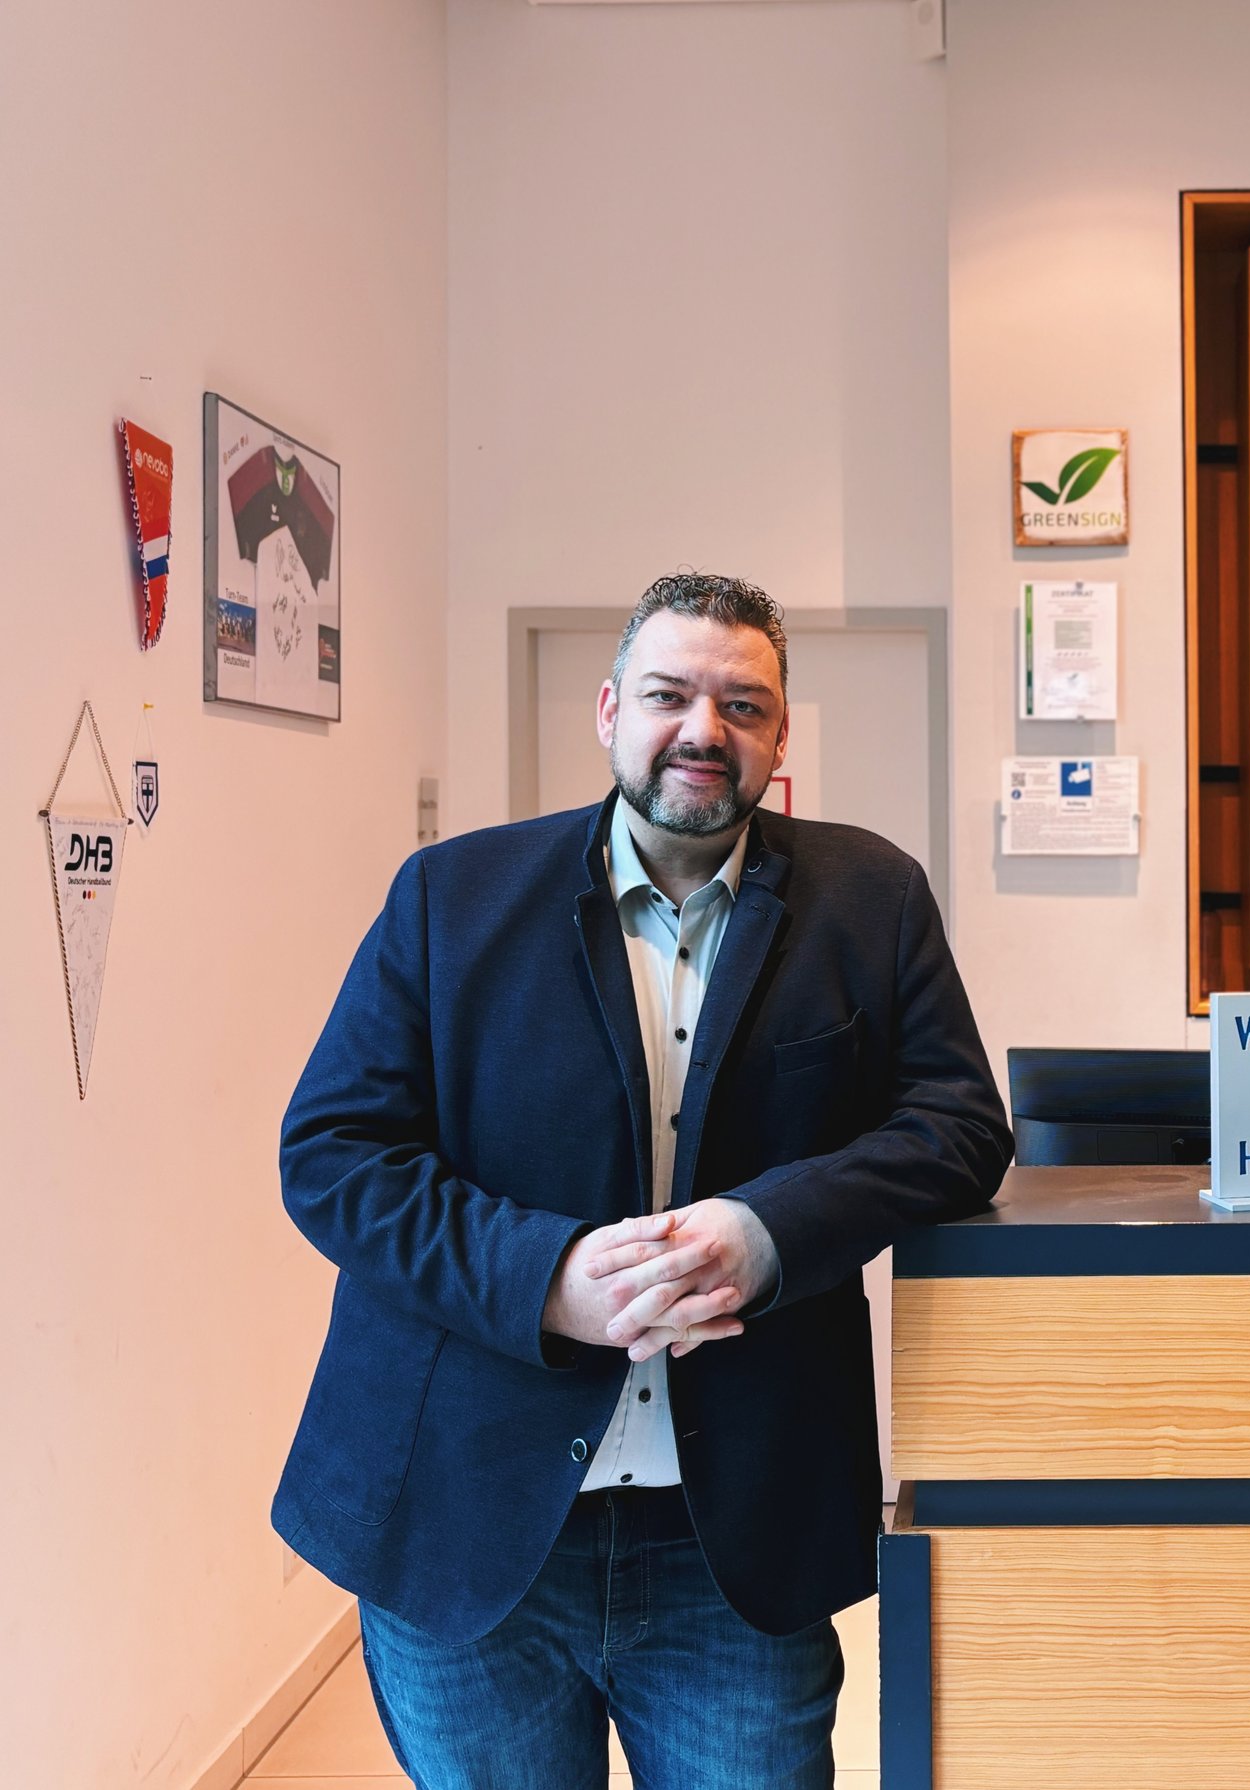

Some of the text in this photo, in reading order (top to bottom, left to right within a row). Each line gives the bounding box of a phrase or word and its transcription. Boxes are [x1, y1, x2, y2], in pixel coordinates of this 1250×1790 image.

[143, 452, 168, 477] nevobo
[1021, 512, 1122, 527] GREENSIGN
[64, 833, 113, 873] DHB
